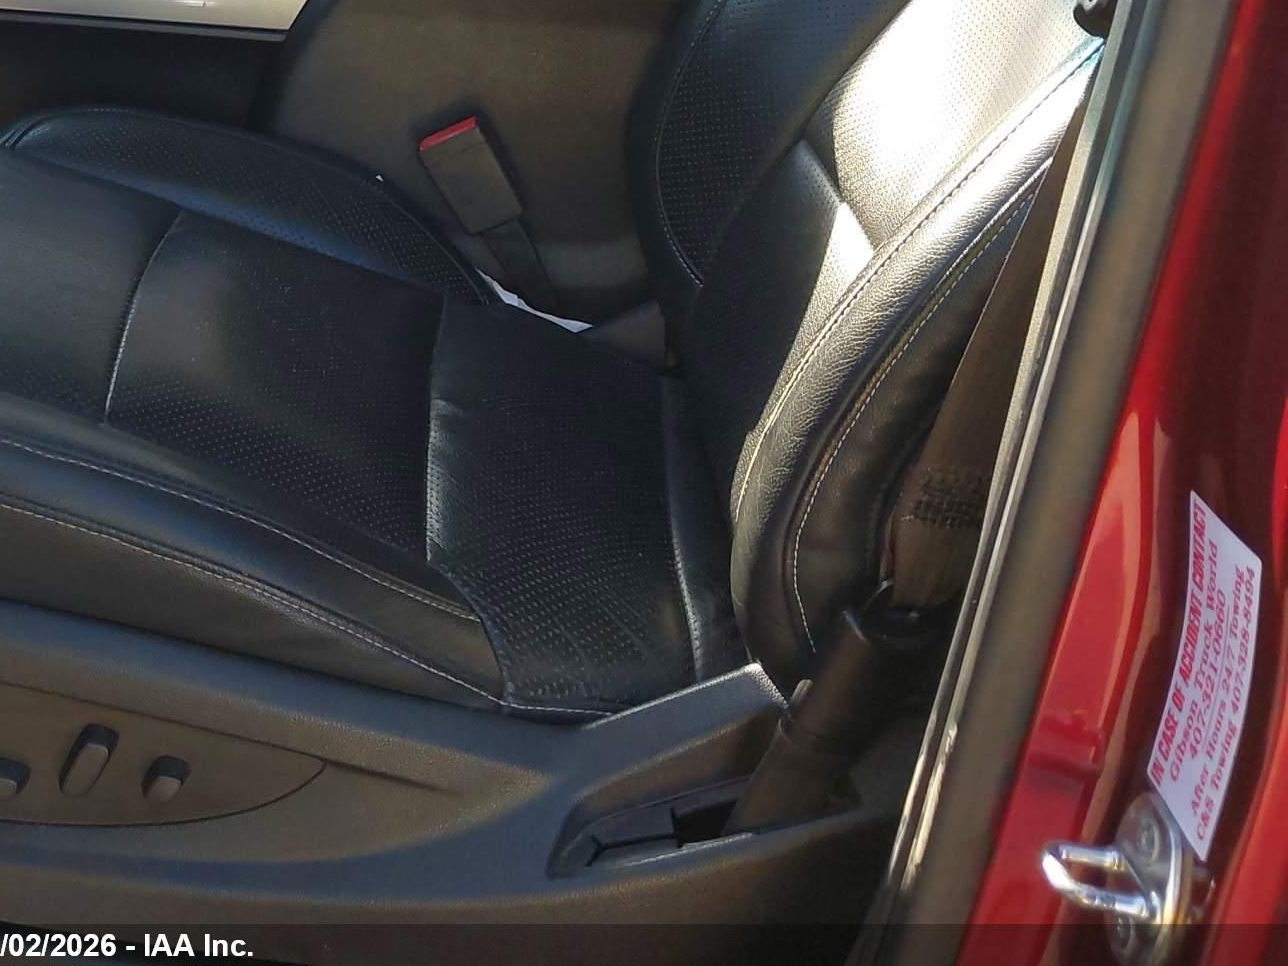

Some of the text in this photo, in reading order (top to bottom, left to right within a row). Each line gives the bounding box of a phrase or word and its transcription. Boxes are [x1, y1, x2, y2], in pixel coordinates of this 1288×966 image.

[1150, 501, 1206, 787] IN CASE OF ACCIDENT CONTACT
[1169, 538, 1218, 782] Gibson Truck World
[1189, 589, 1226, 760] 407-321-0660
[1191, 564, 1245, 816] After Hours 24/7 Towing
[1210, 718, 1238, 791] Towing
[1230, 565, 1256, 715] 407-328-8494
